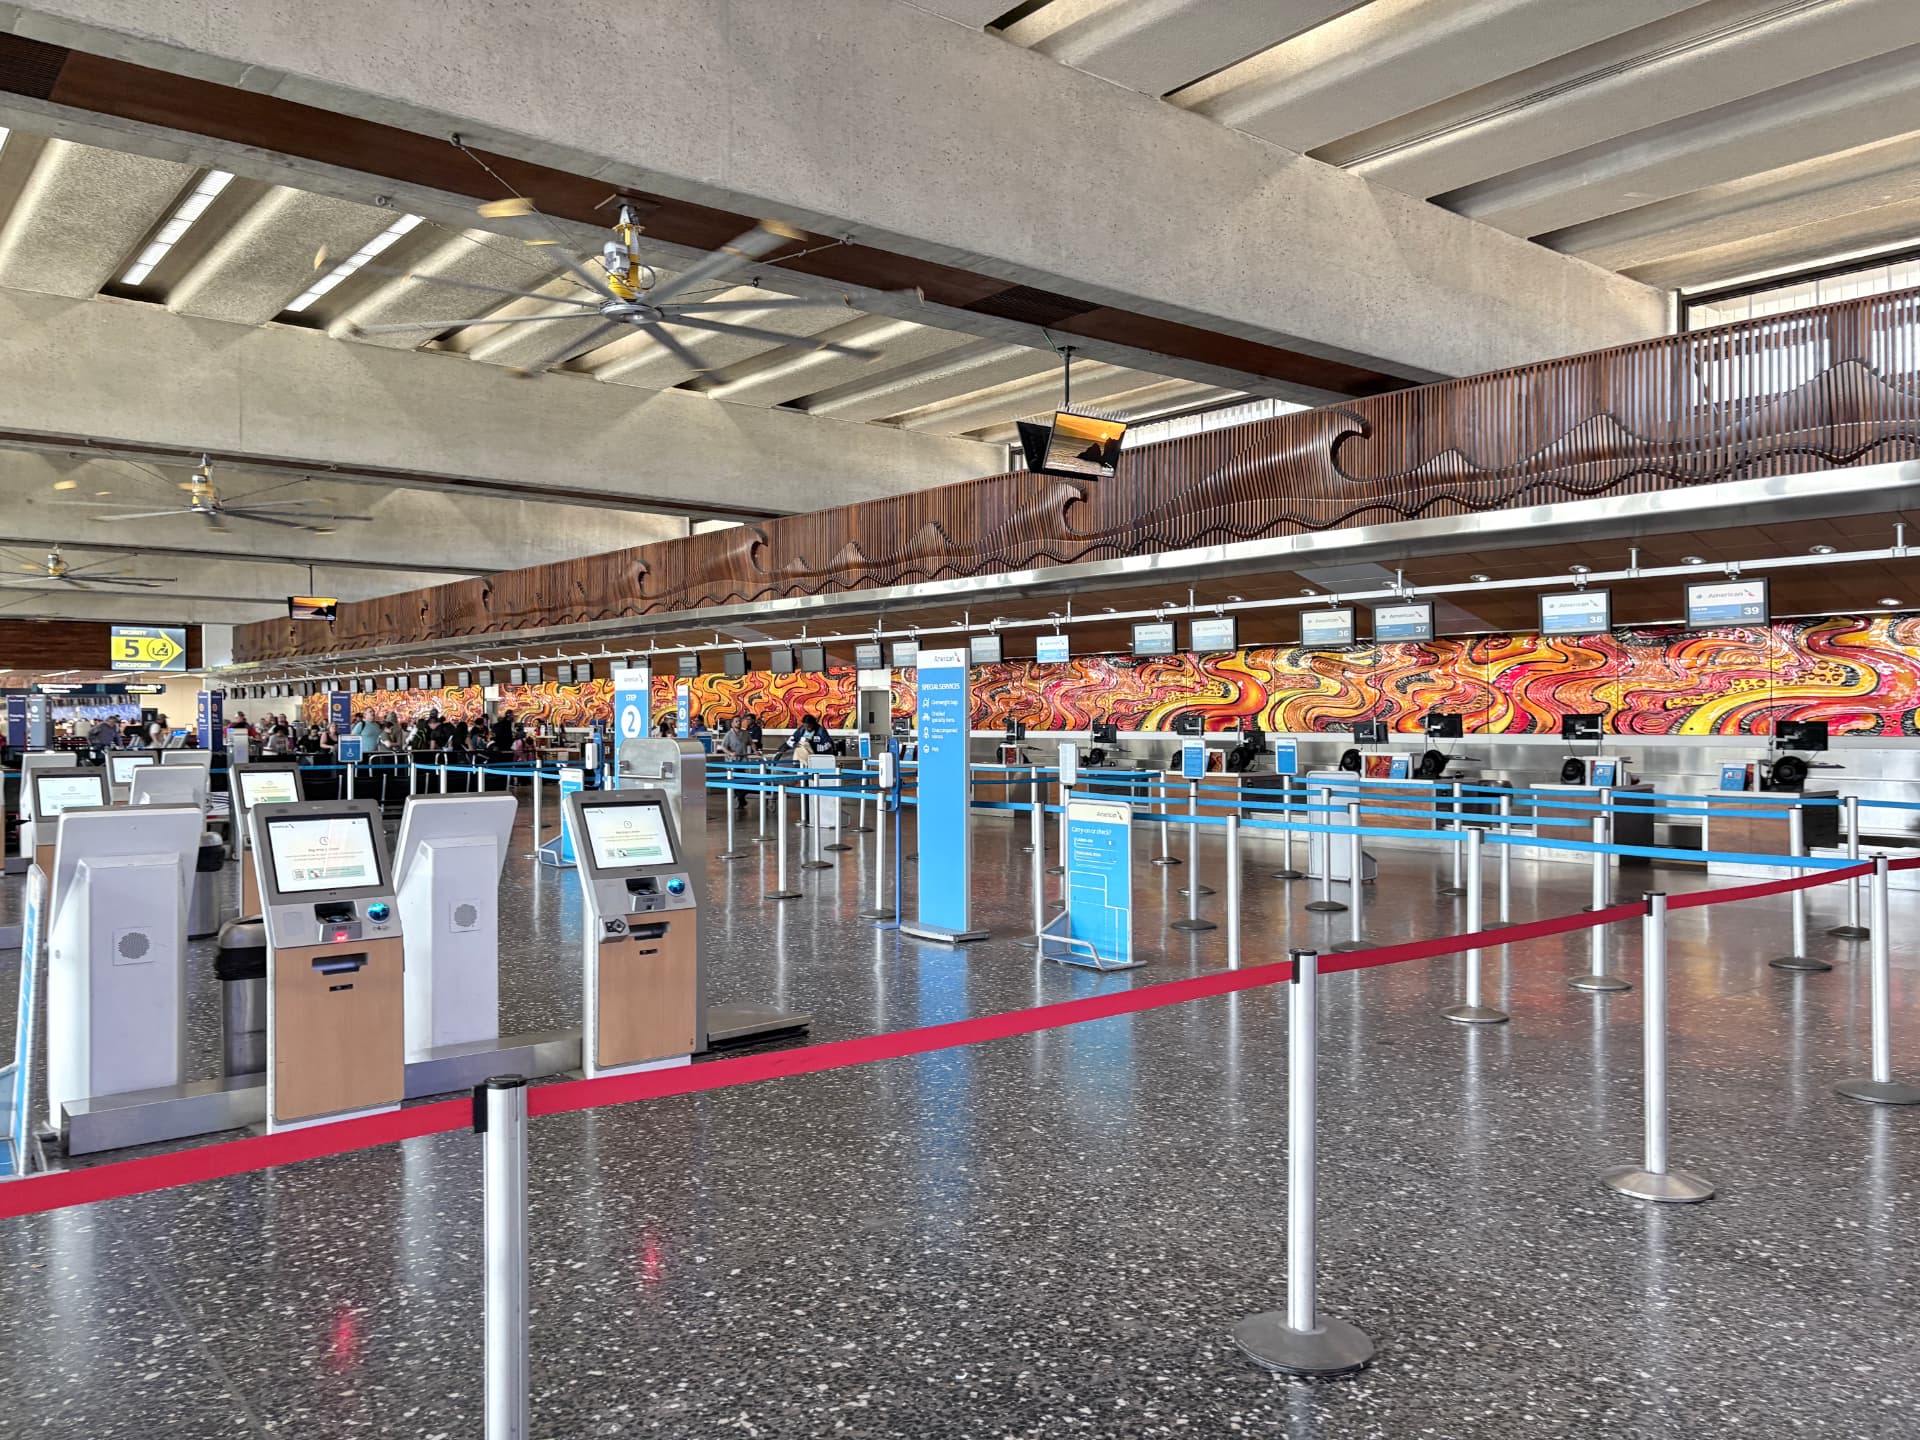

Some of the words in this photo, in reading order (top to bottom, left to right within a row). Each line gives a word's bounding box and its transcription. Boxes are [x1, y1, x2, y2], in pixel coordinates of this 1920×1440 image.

[1743, 606, 1760, 615] 39
[1590, 616, 1602, 624] 38
[124, 639, 140, 658] 5
[628, 711, 636, 732] 2
